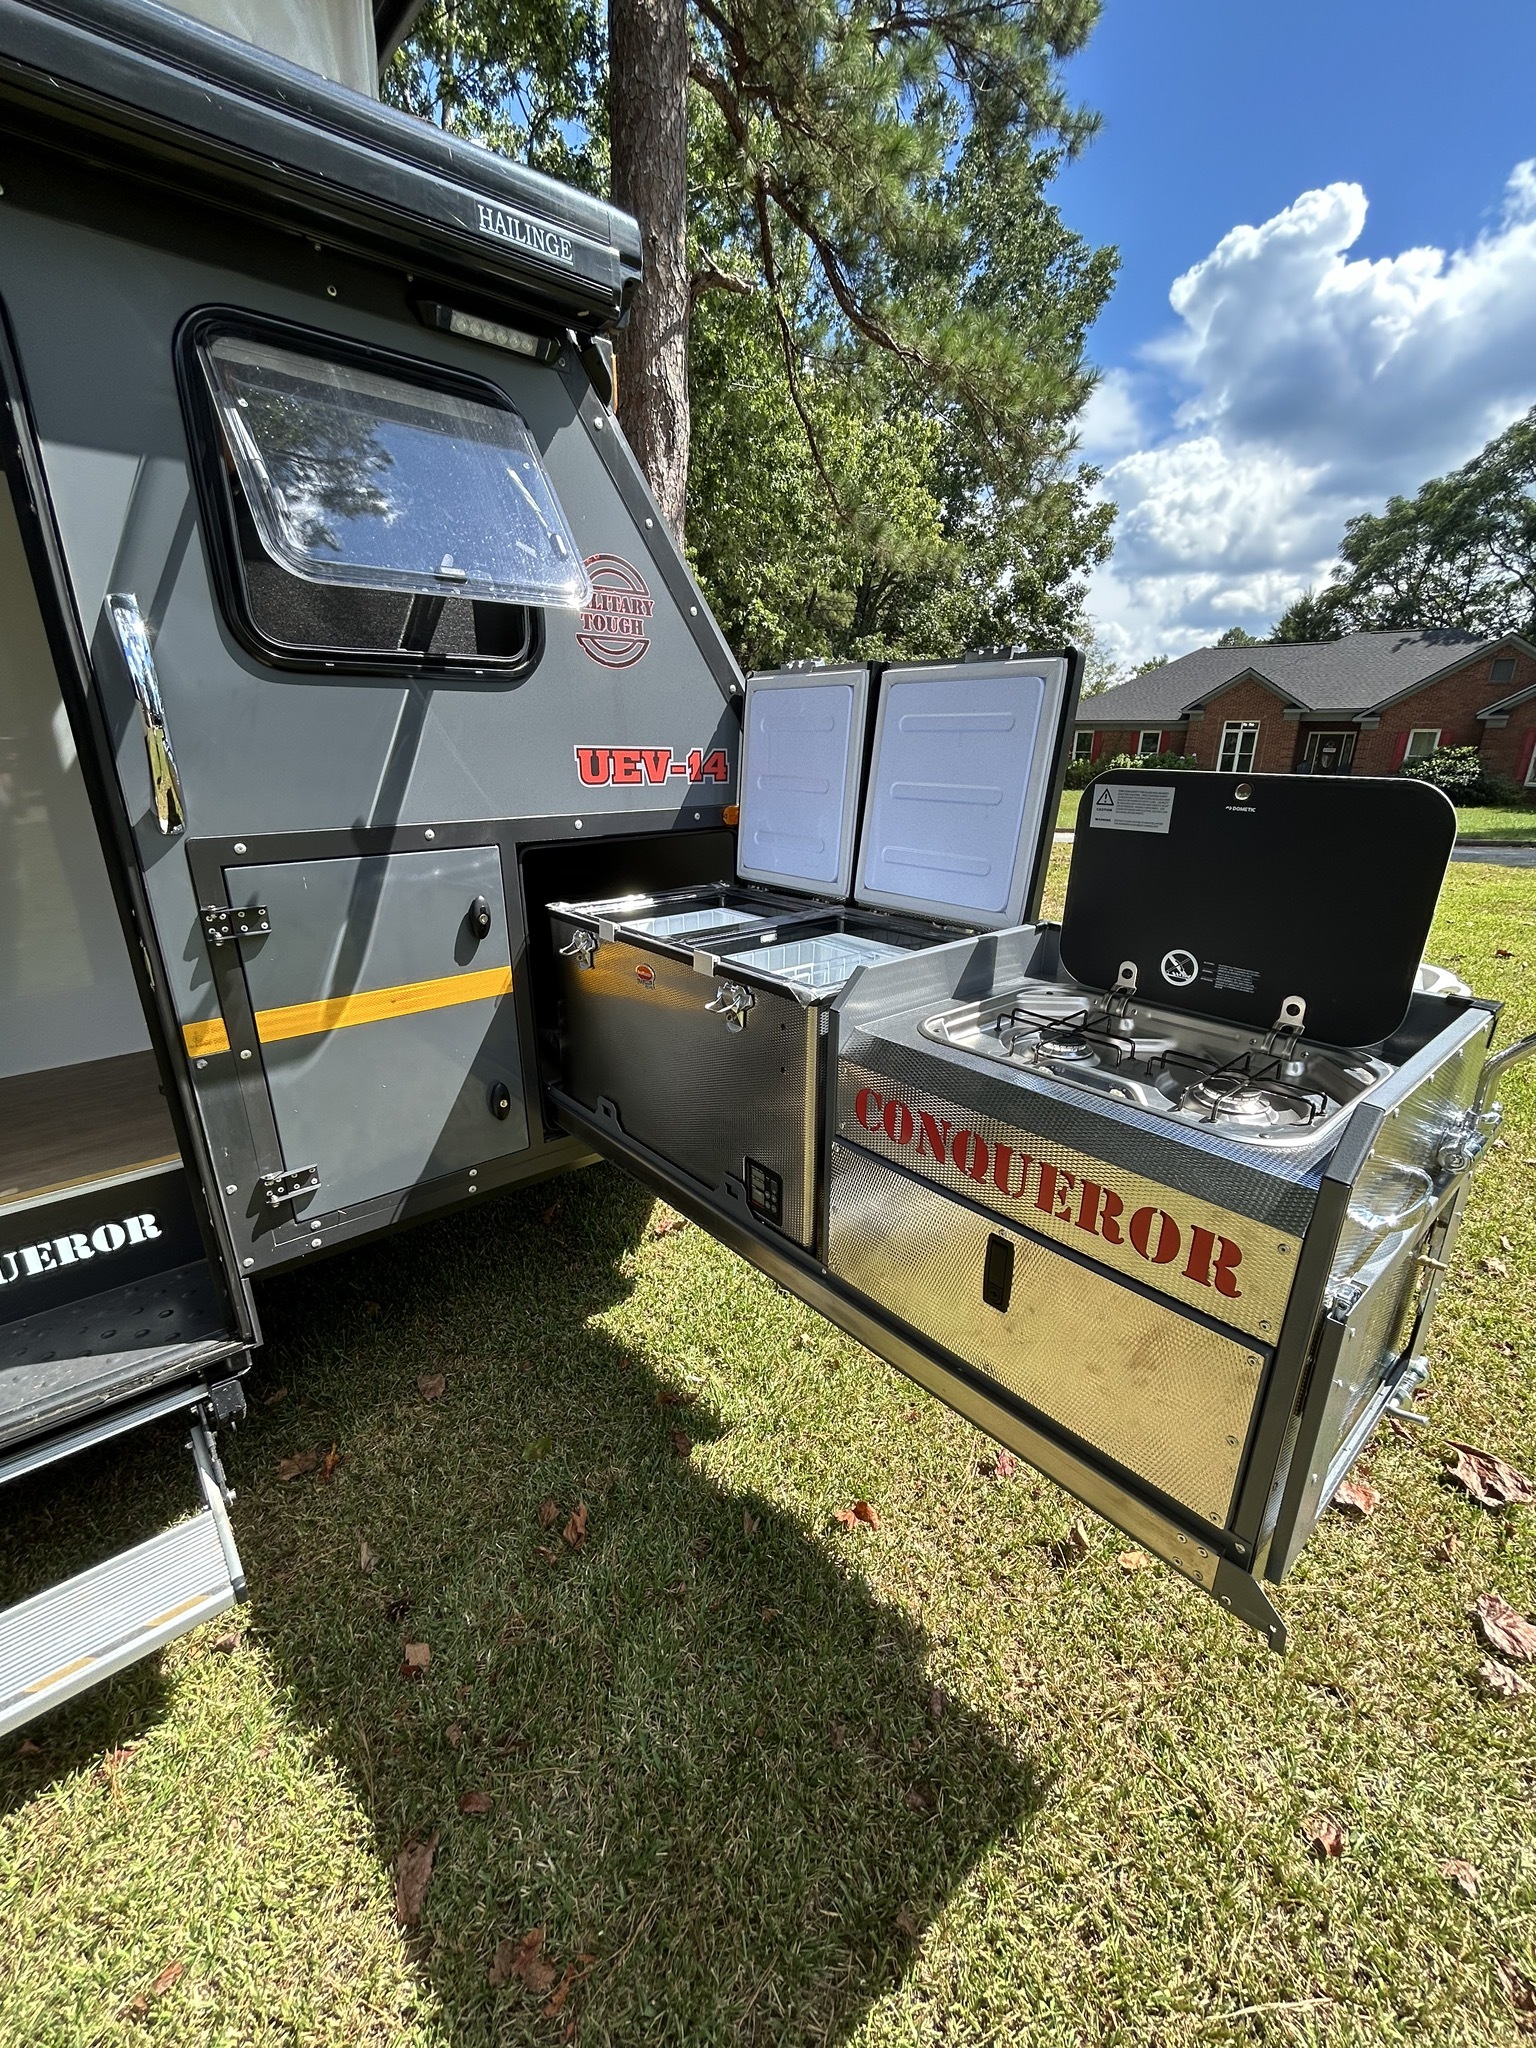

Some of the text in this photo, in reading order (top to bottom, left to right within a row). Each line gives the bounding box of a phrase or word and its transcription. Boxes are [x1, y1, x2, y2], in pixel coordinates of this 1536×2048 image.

[477, 204, 573, 262] HAILINGE
[580, 612, 645, 636] TOUGH
[585, 591, 654, 618] LITARY
[573, 745, 730, 788] UEV-14
[855, 1088, 1243, 1298] CONQUEROR
